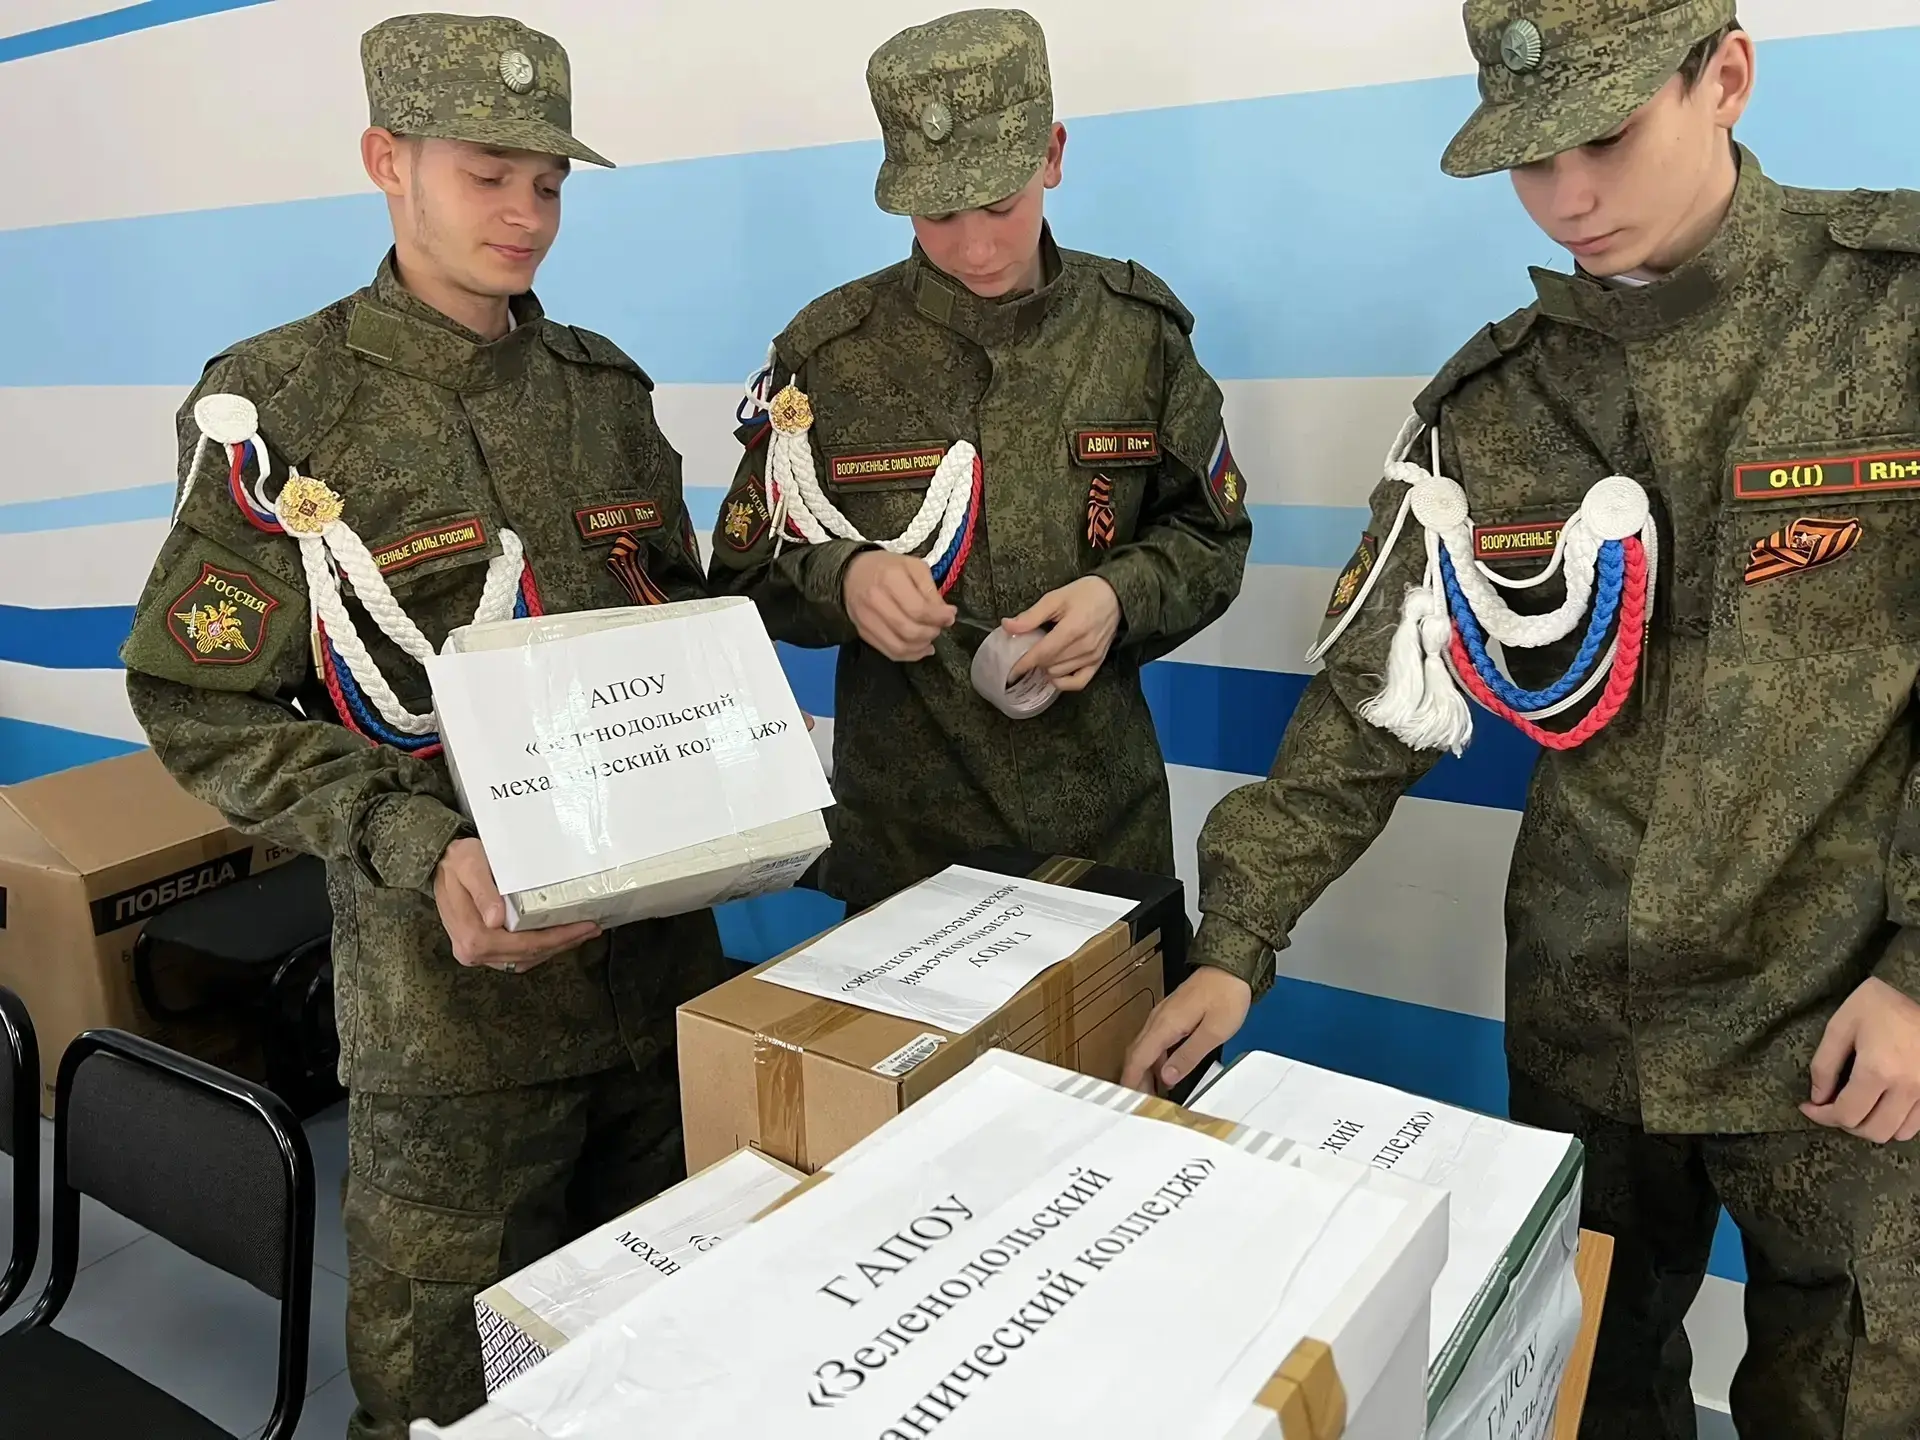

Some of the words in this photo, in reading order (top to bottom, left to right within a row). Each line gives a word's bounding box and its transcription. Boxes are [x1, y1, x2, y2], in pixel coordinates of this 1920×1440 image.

[836, 459, 891, 476] ВООРУЖЕННЫЕ
[891, 457, 912, 471] СИЛЫ
[913, 453, 941, 468] РОССИИ
[1127, 437, 1150, 451] Rh+
[1870, 460, 1920, 480] Rh+
[746, 483, 770, 521] РОССИЯ
[373, 544, 411, 567] ЖЕННЫЕ
[411, 536, 441, 554] СИЛЫ
[440, 526, 476, 546] РОССИИ
[1480, 530, 1553, 550] ВООРУЖЕННЫЕ
[203, 573, 268, 613] РОССИЯ
[581, 674, 666, 709] АПОУ
[115, 861, 236, 921] ПОБЕДА
[920, 884, 1019, 945] механический
[899, 904, 1024, 986] «Зеленодольский
[969, 931, 1032, 968] ГАПОУ
[841, 946, 922, 992] колледж»
[1370, 1111, 1435, 1170] лледж»
[1075, 1158, 1216, 1272] колледж»
[817, 1194, 973, 1308] ГАПОУ
[807, 1167, 1113, 1409] «Зеленодольский
